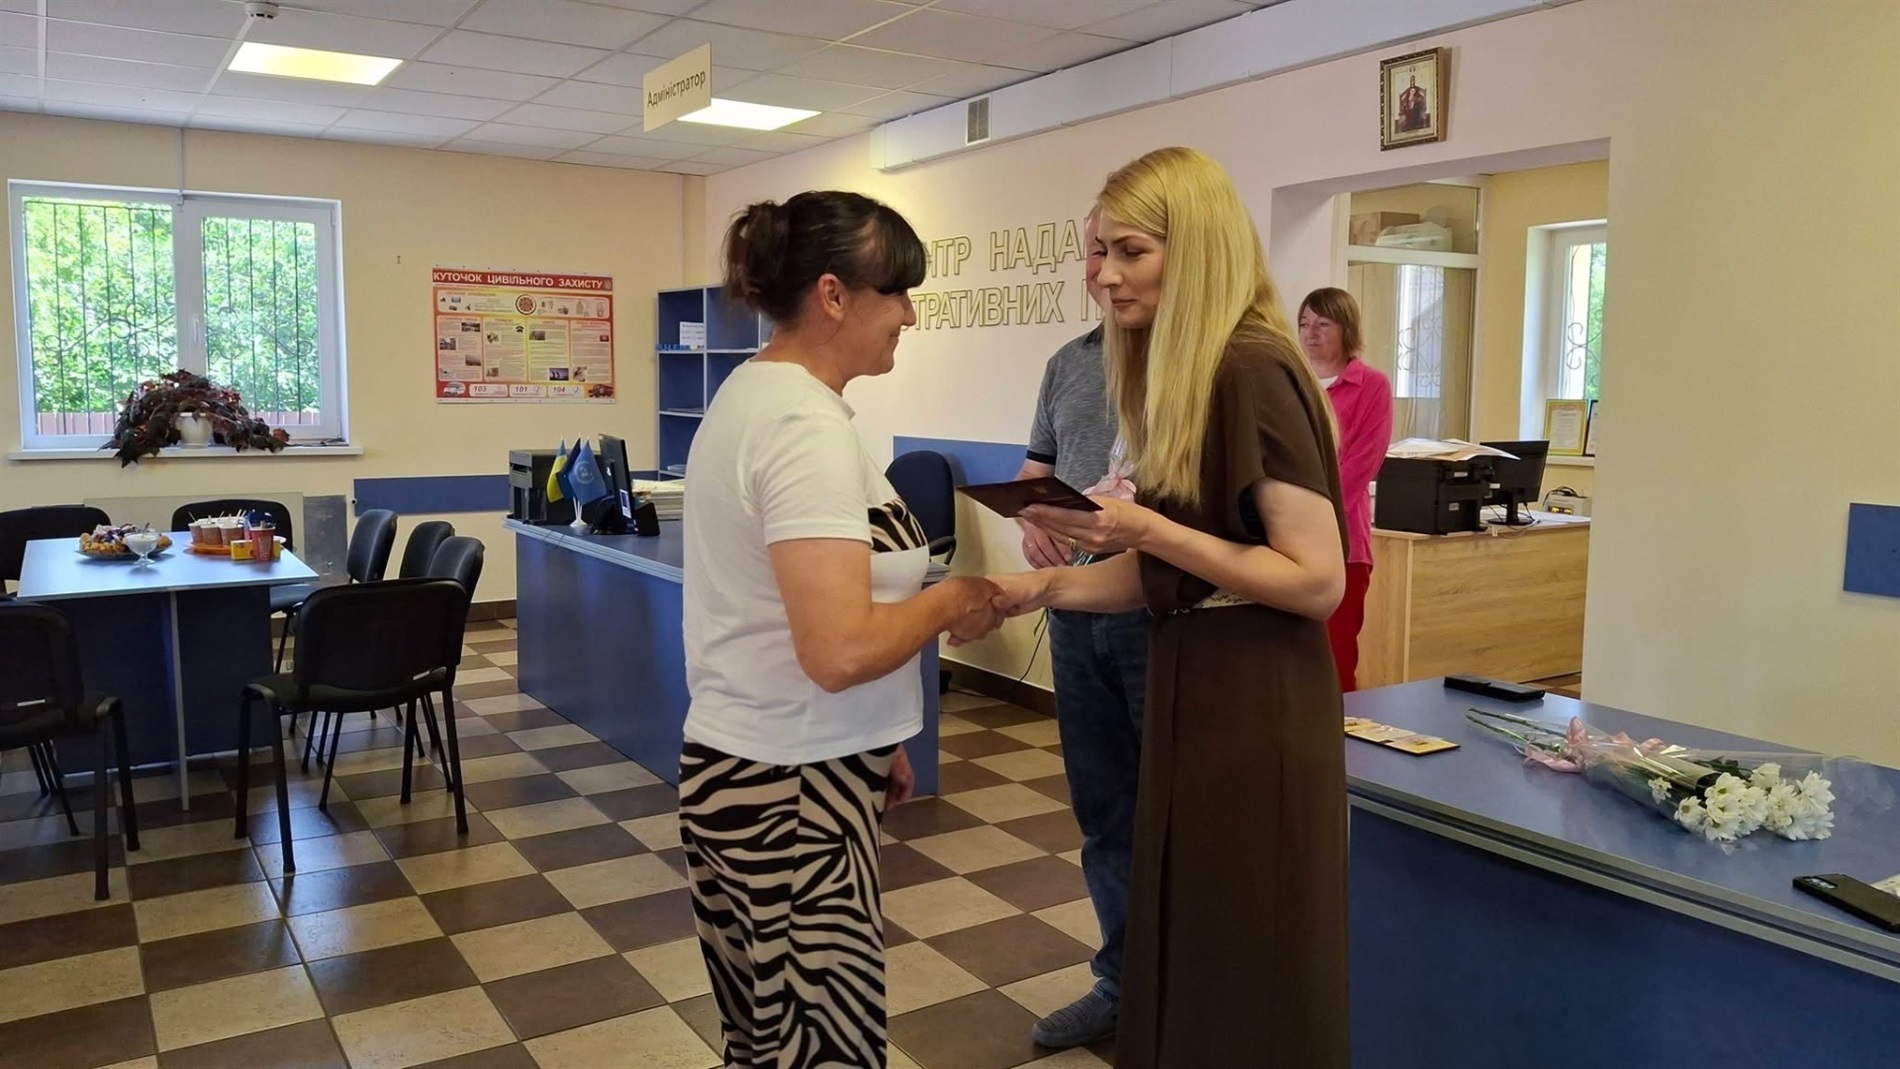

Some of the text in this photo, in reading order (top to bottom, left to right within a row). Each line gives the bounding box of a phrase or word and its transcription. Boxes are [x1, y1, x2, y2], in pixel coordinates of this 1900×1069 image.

[647, 70, 706, 108] Адміністратор
[926, 218, 1088, 278] НТР НАДА
[433, 271, 483, 283] КУТОЧОК
[487, 274, 554, 287] ЦИВІЛЬНОГО
[558, 279, 603, 290] ЗАХИСТУ
[903, 281, 1065, 331] ТРАТИВНИХ
[473, 385, 487, 393] 103
